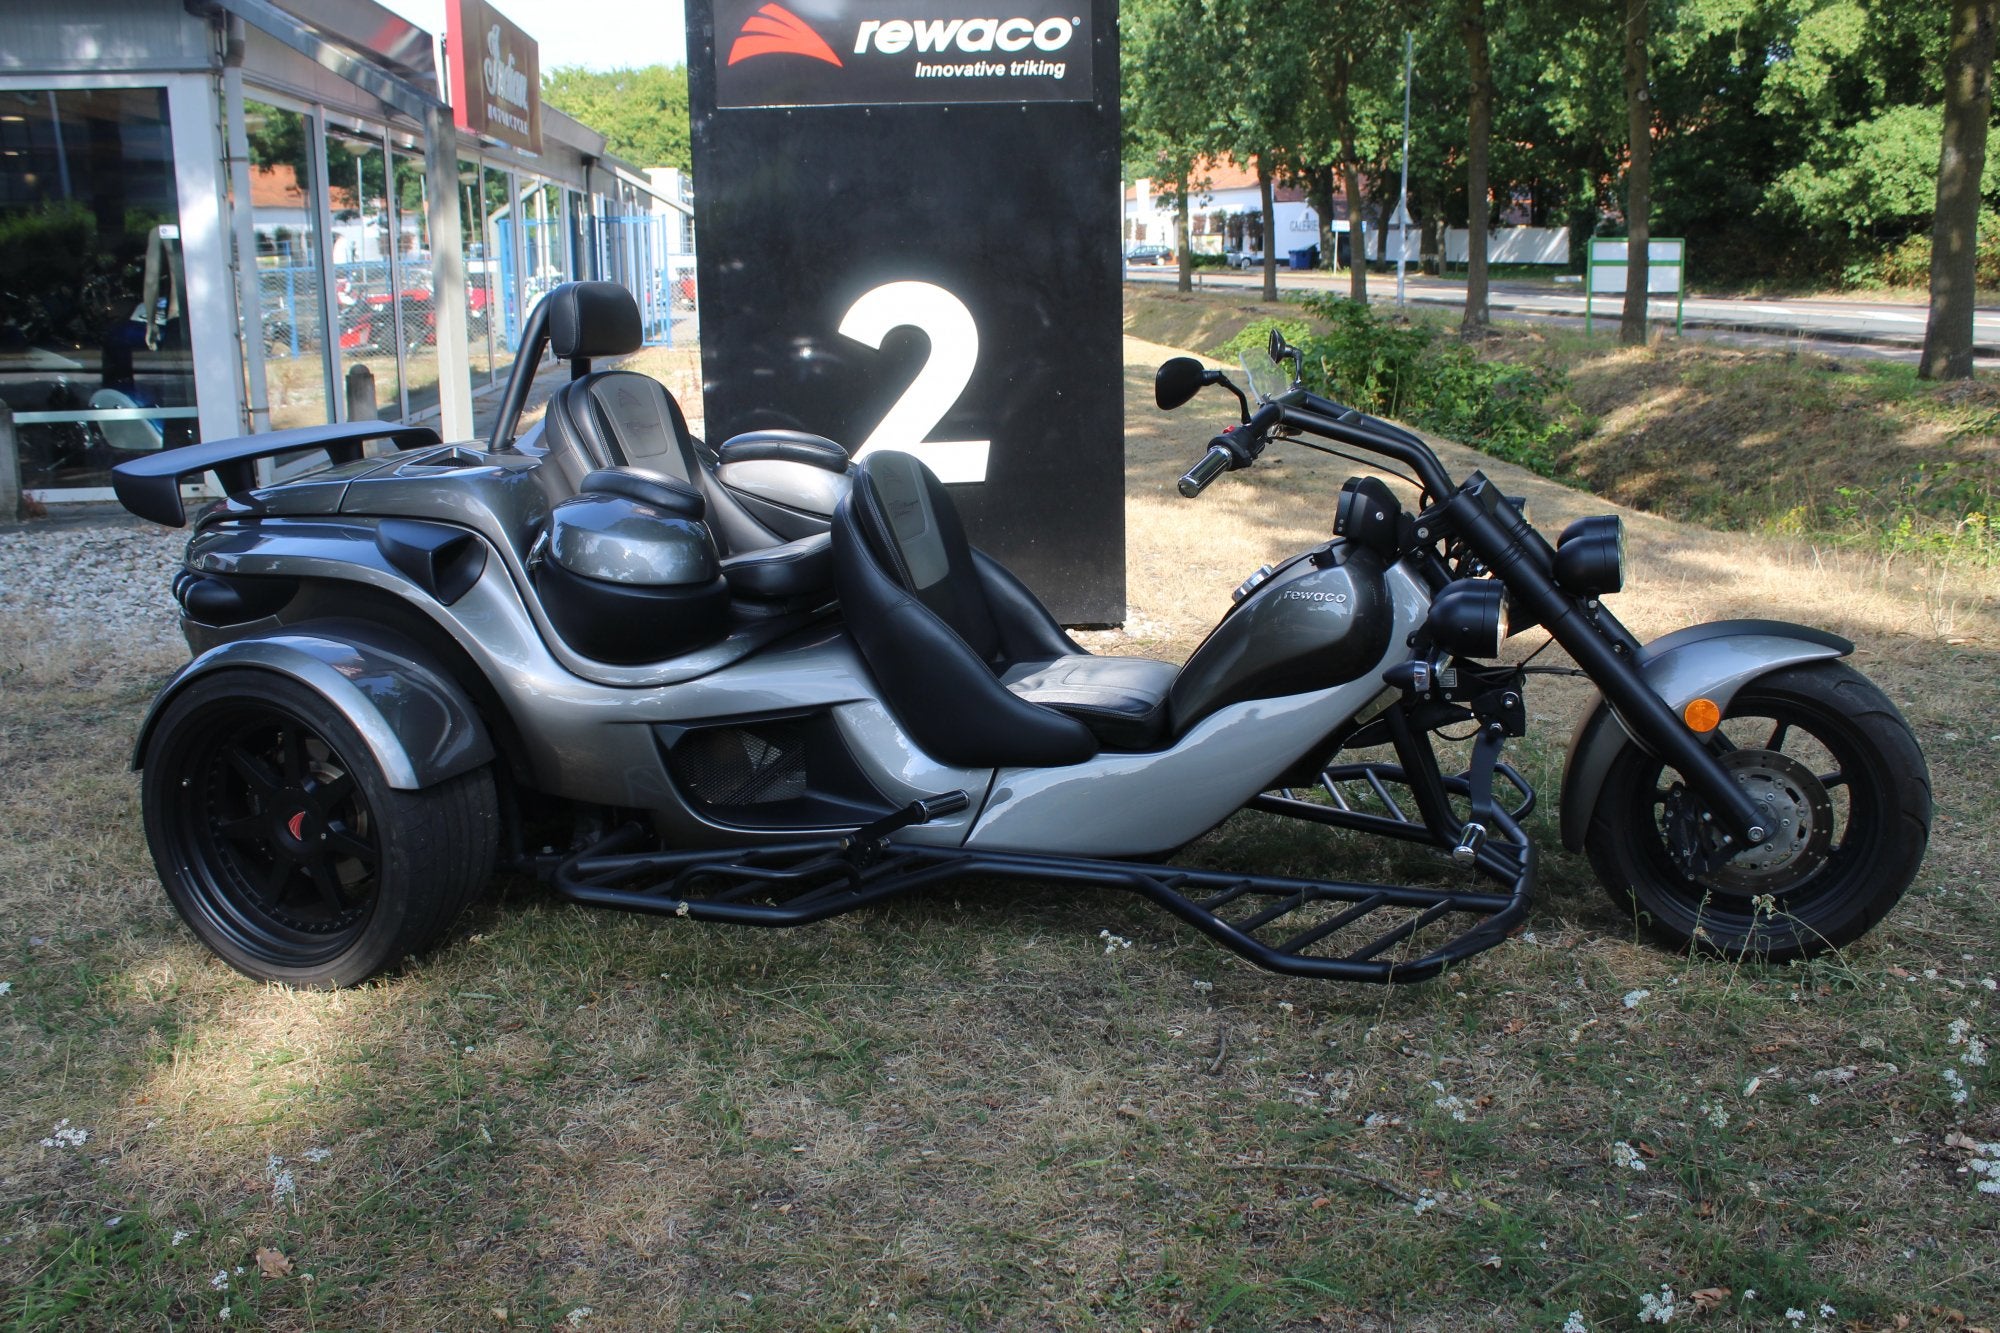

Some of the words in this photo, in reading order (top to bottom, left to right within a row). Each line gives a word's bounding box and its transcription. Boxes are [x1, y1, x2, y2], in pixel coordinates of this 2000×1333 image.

[853, 17, 1073, 54] rewaco
[915, 61, 1006, 78] Innovative
[1010, 59, 1067, 79] triking
[838, 281, 991, 484] 2
[1283, 590, 1347, 603] rewaco
